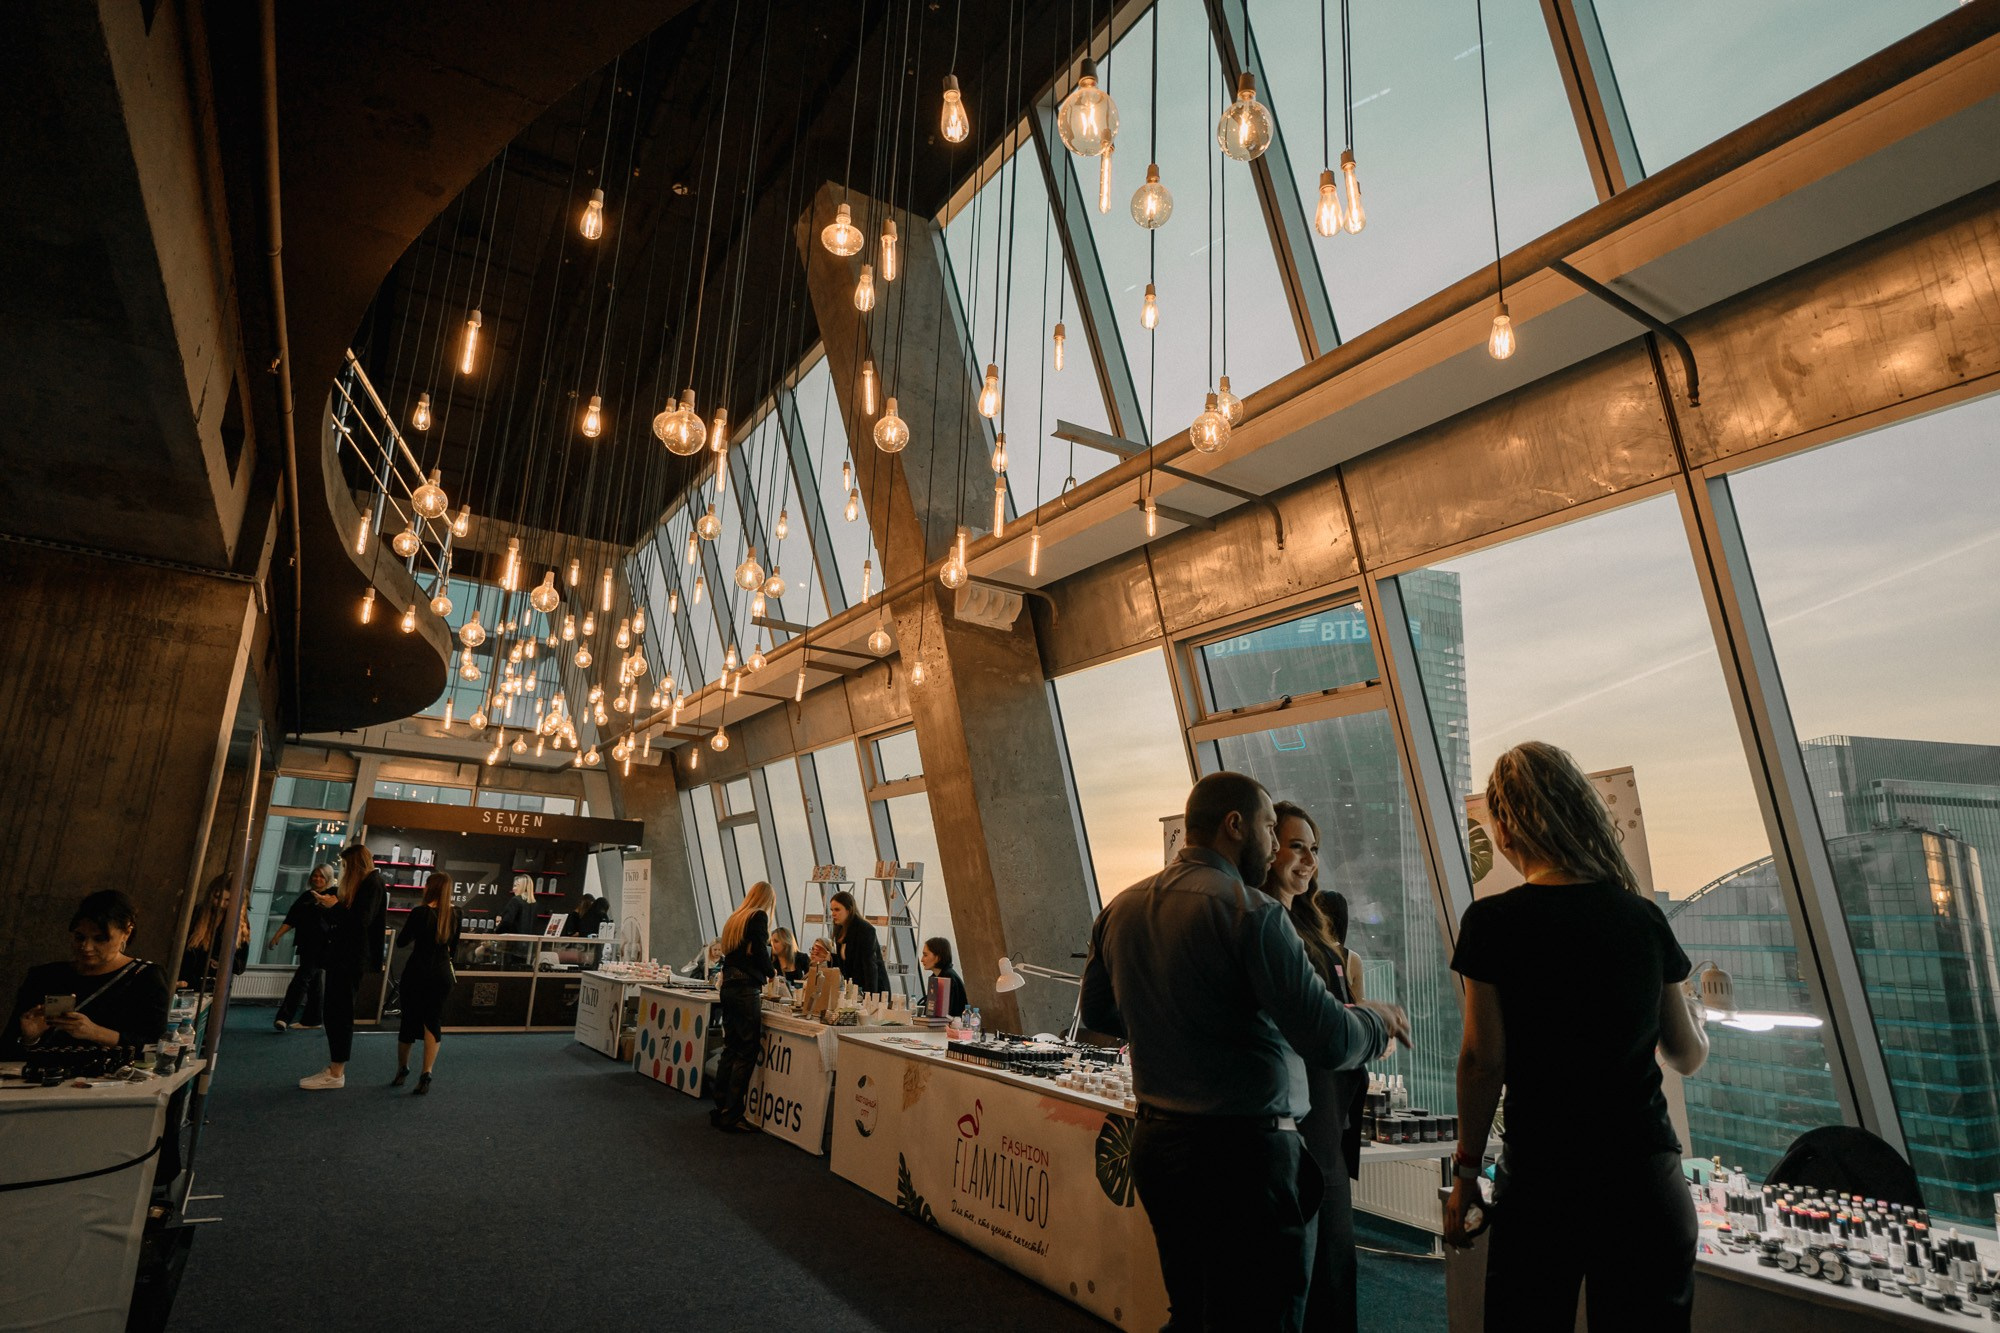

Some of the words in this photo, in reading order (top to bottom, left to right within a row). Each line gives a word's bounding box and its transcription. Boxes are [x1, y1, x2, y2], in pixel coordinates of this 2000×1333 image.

[1321, 620, 1367, 641] ВТБ
[482, 811, 543, 827] SEVEN
[498, 825, 526, 834] TONES
[453, 882, 498, 895] EVEN
[756, 1033, 792, 1075] Skin
[744, 1081, 803, 1132] elpers
[1001, 1136, 1049, 1167] FASHION
[953, 1138, 1049, 1229] FLAMINGO
[951, 1199, 963, 1217] Для
[978, 1217, 990, 1230] кто
[991, 1224, 1013, 1240] ценит
[1013, 1235, 1050, 1258] качество!
